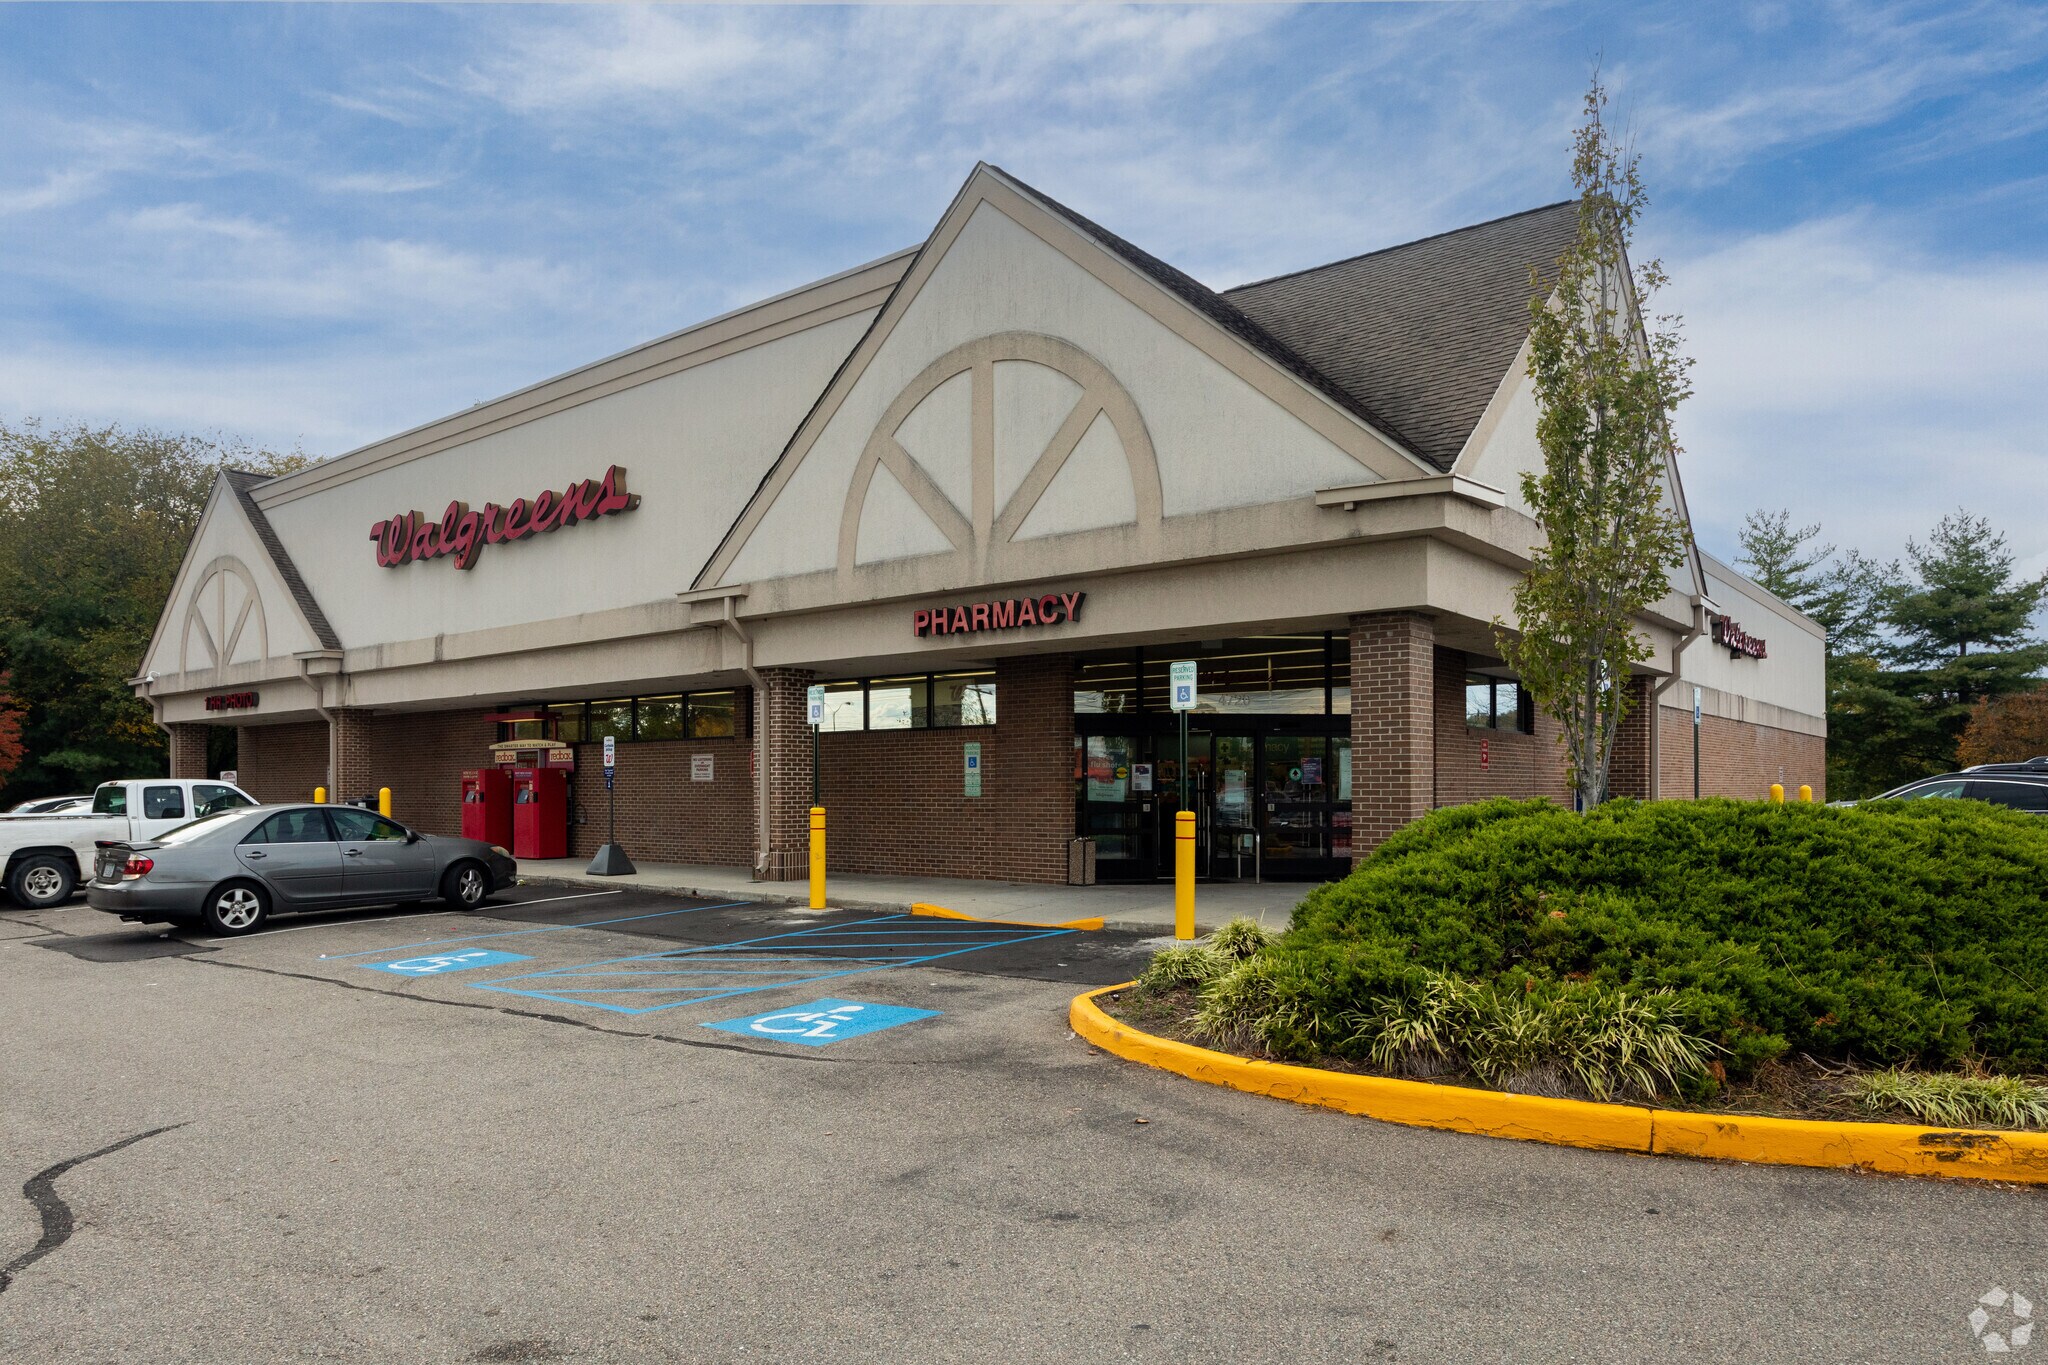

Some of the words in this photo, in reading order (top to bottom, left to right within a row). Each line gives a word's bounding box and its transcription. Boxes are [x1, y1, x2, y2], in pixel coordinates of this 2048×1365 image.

[369, 464, 640, 570] Walgreens
[914, 591, 1084, 637] PHARMACY
[1713, 615, 1767, 659] Walgreens
[225, 692, 255, 708] PHOTO
[1219, 694, 1250, 706] 4720
